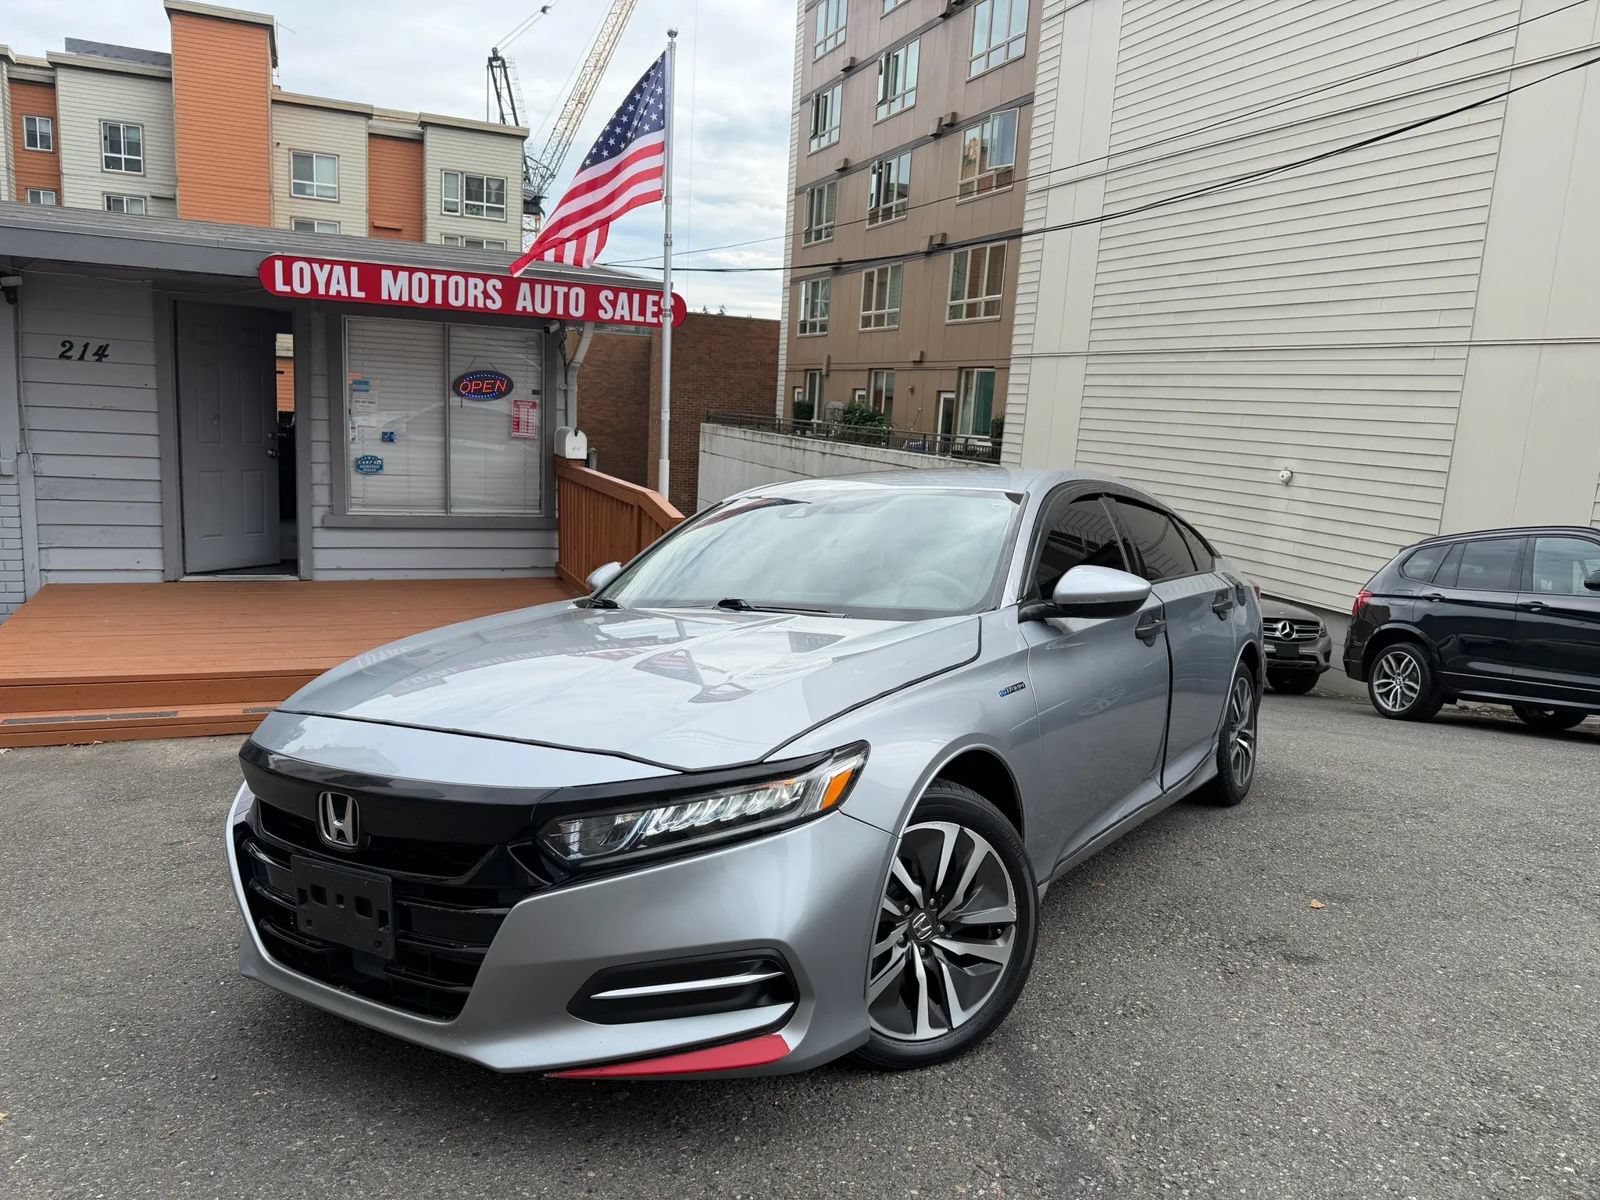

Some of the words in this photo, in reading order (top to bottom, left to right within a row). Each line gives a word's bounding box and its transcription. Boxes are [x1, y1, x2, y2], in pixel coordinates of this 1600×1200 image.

[274, 260, 366, 298] LOYAL
[380, 269, 503, 311] MOTORS
[515, 282, 586, 318] AUTO
[58, 340, 110, 362] 214
[460, 379, 507, 394] OPEN
